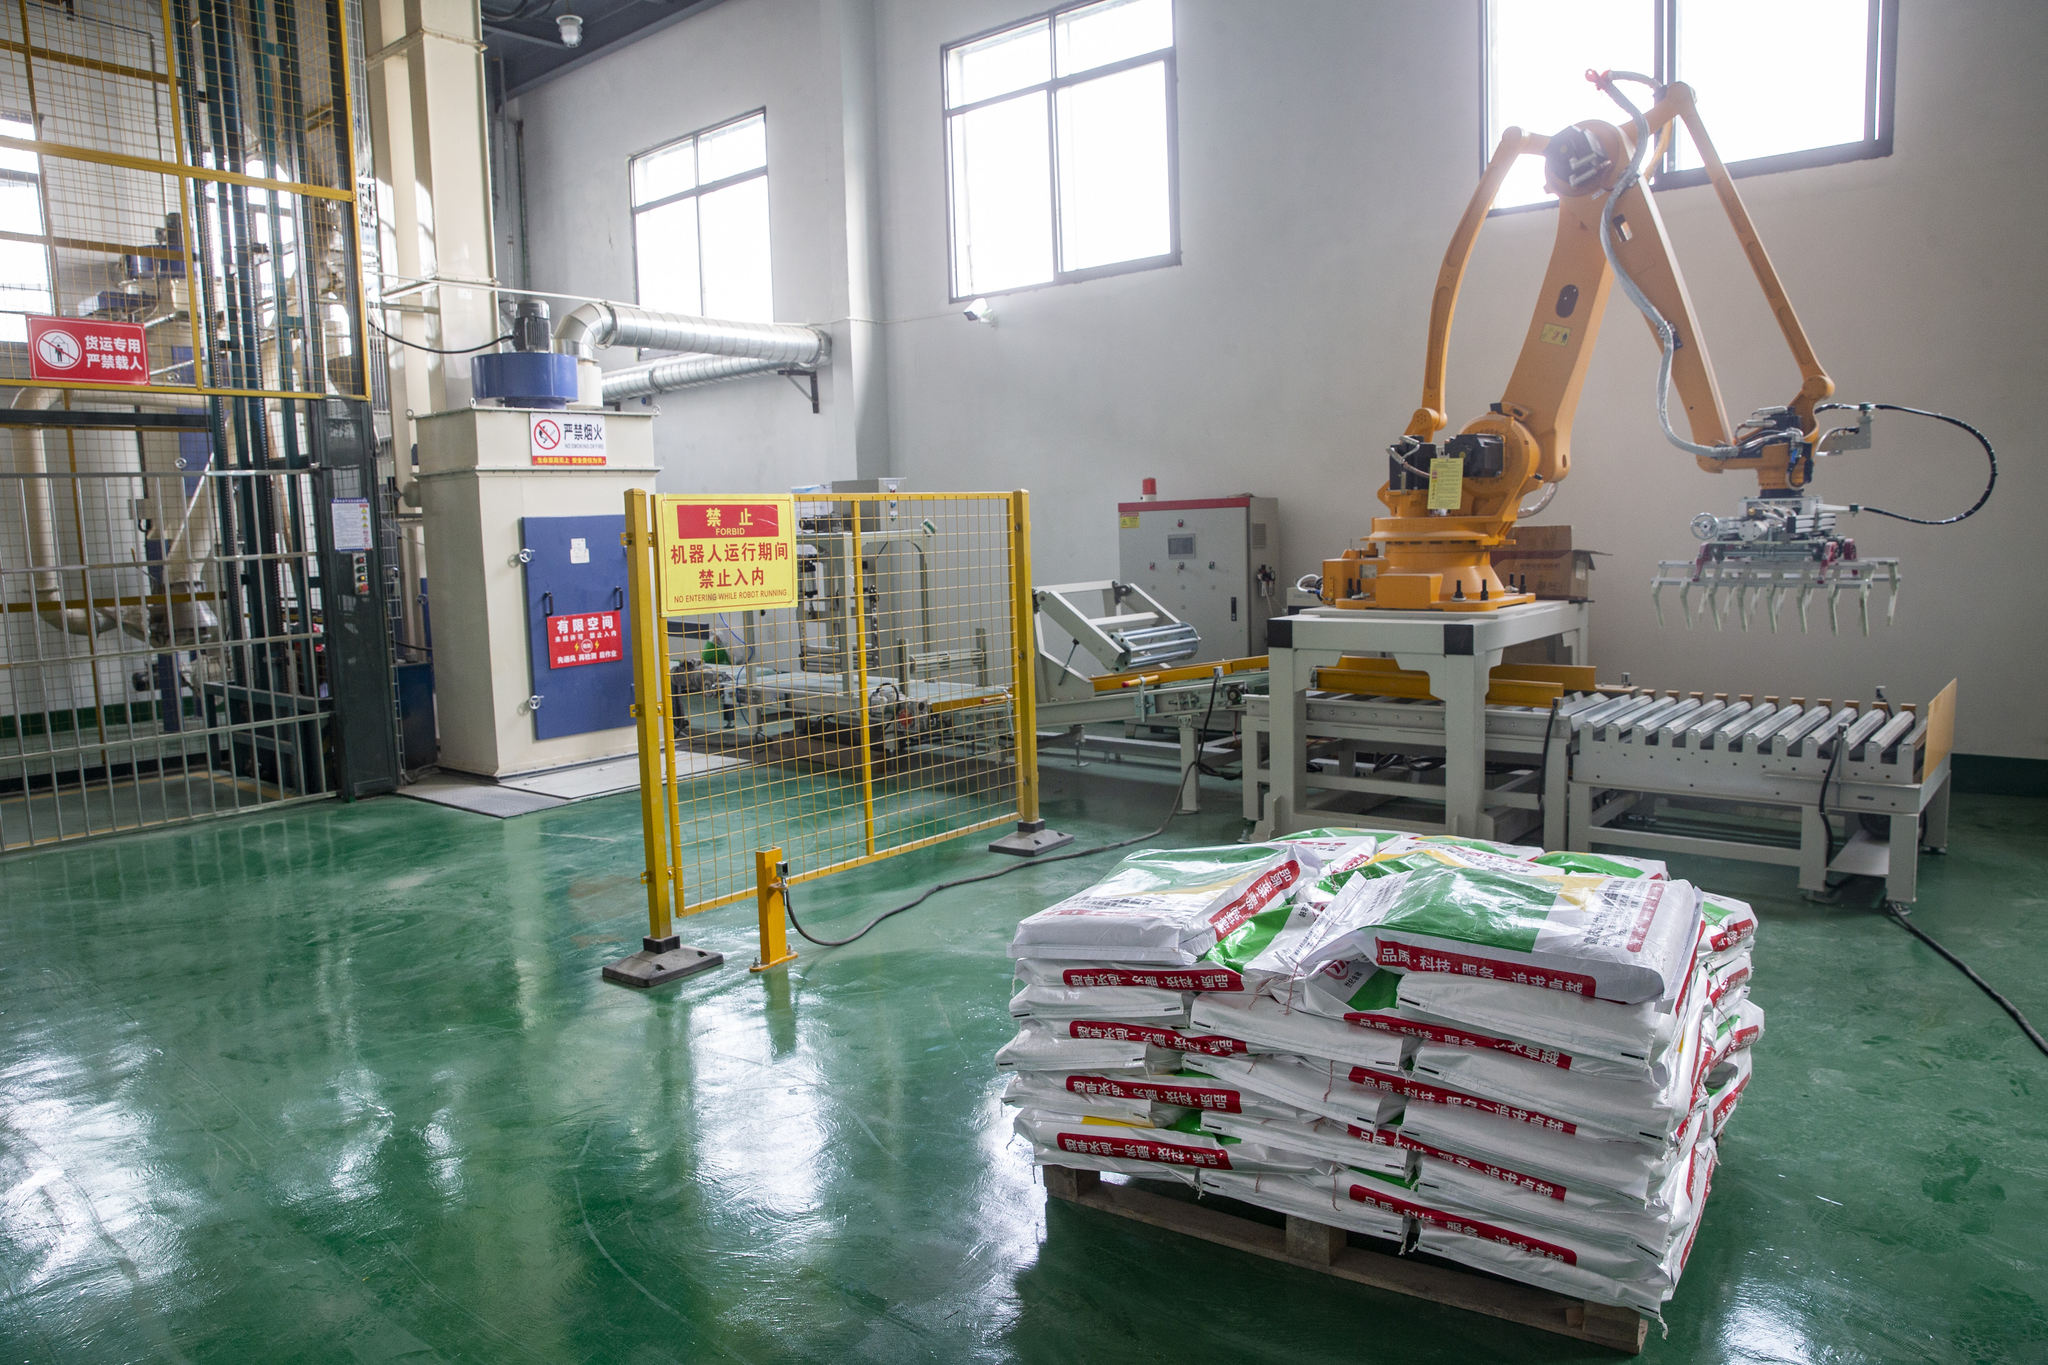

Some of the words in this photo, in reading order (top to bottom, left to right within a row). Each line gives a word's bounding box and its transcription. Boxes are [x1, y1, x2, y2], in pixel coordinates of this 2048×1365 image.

[84, 335, 141, 353] 货运专用
[86, 353, 143, 371] 严禁载人
[563, 423, 602, 440] 严禁烟火
[715, 527, 746, 536] FORBID
[670, 542, 789, 565] 机器人运行期间
[698, 567, 765, 589] 禁止入内
[674, 595, 684, 603] NO
[685, 592, 717, 602] ENTERING
[718, 592, 738, 600] WHILE
[738, 590, 759, 599] ROBOT
[760, 589, 787, 598] RUNNING
[556, 615, 614, 635] 有限空间
